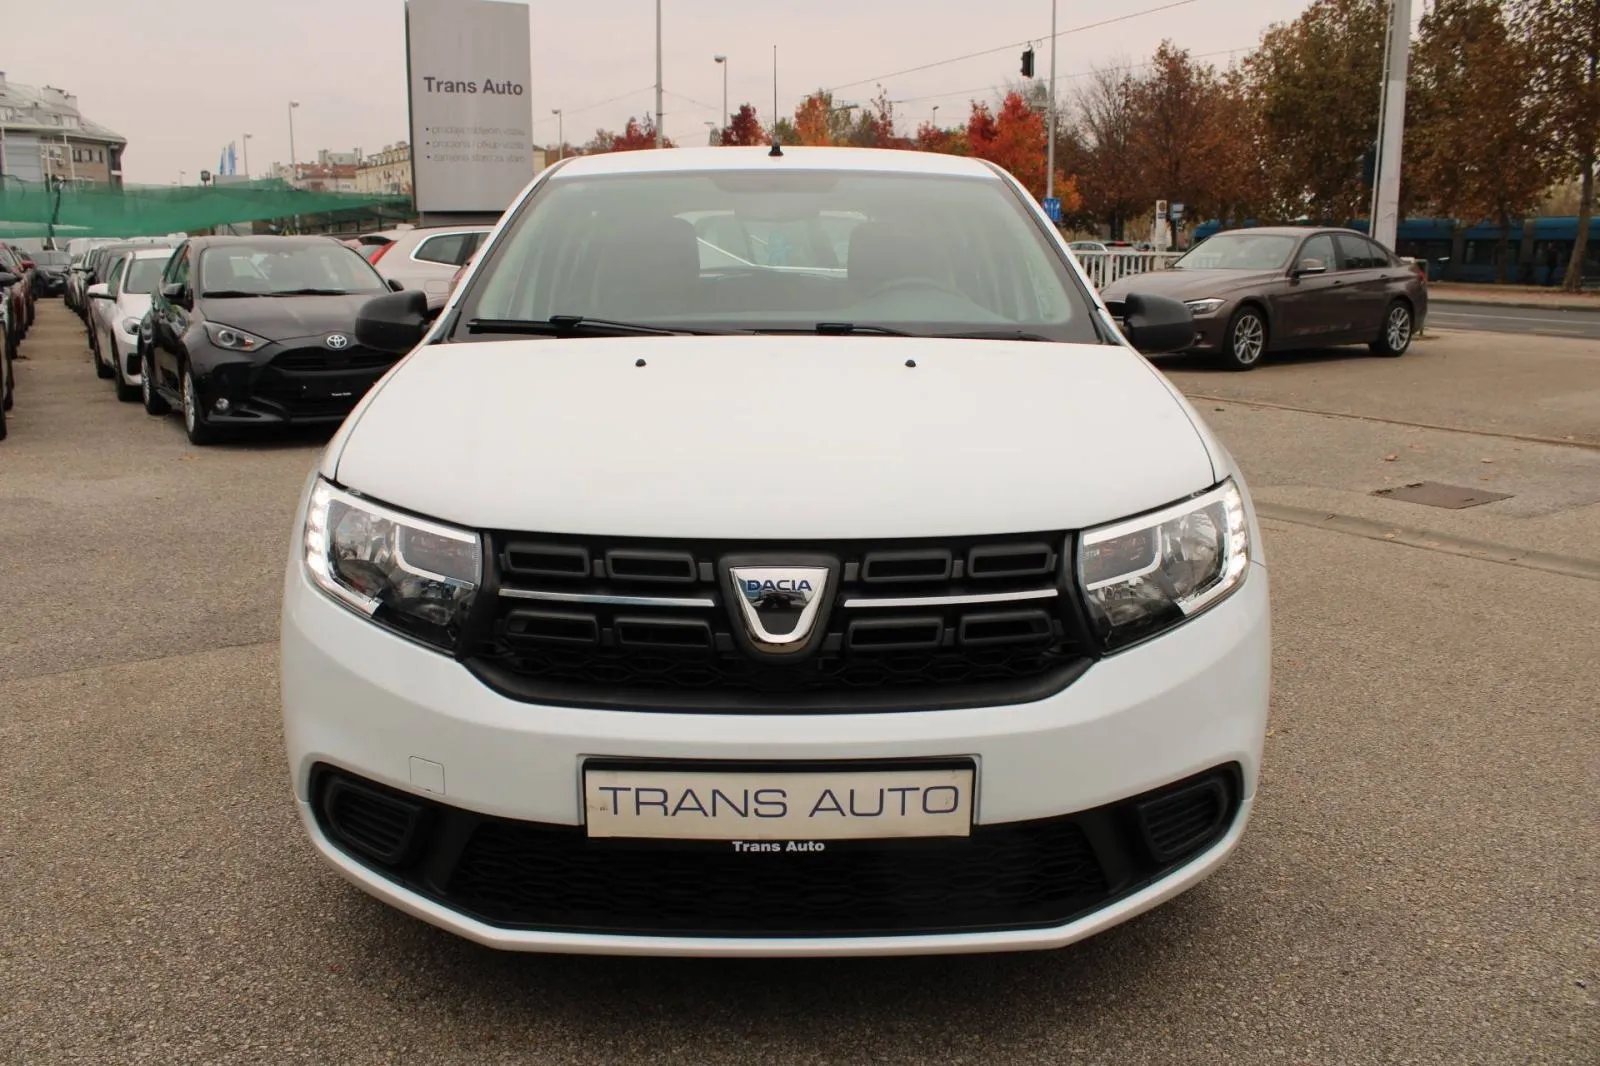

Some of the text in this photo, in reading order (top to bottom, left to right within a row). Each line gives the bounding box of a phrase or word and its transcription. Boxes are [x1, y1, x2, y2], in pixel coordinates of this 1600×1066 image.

[423, 76, 523, 95] Trans Auto
[747, 579, 812, 592] DACIA
[599, 785, 960, 818] TRANS AUTO
[732, 841, 825, 852] Trans Auto
